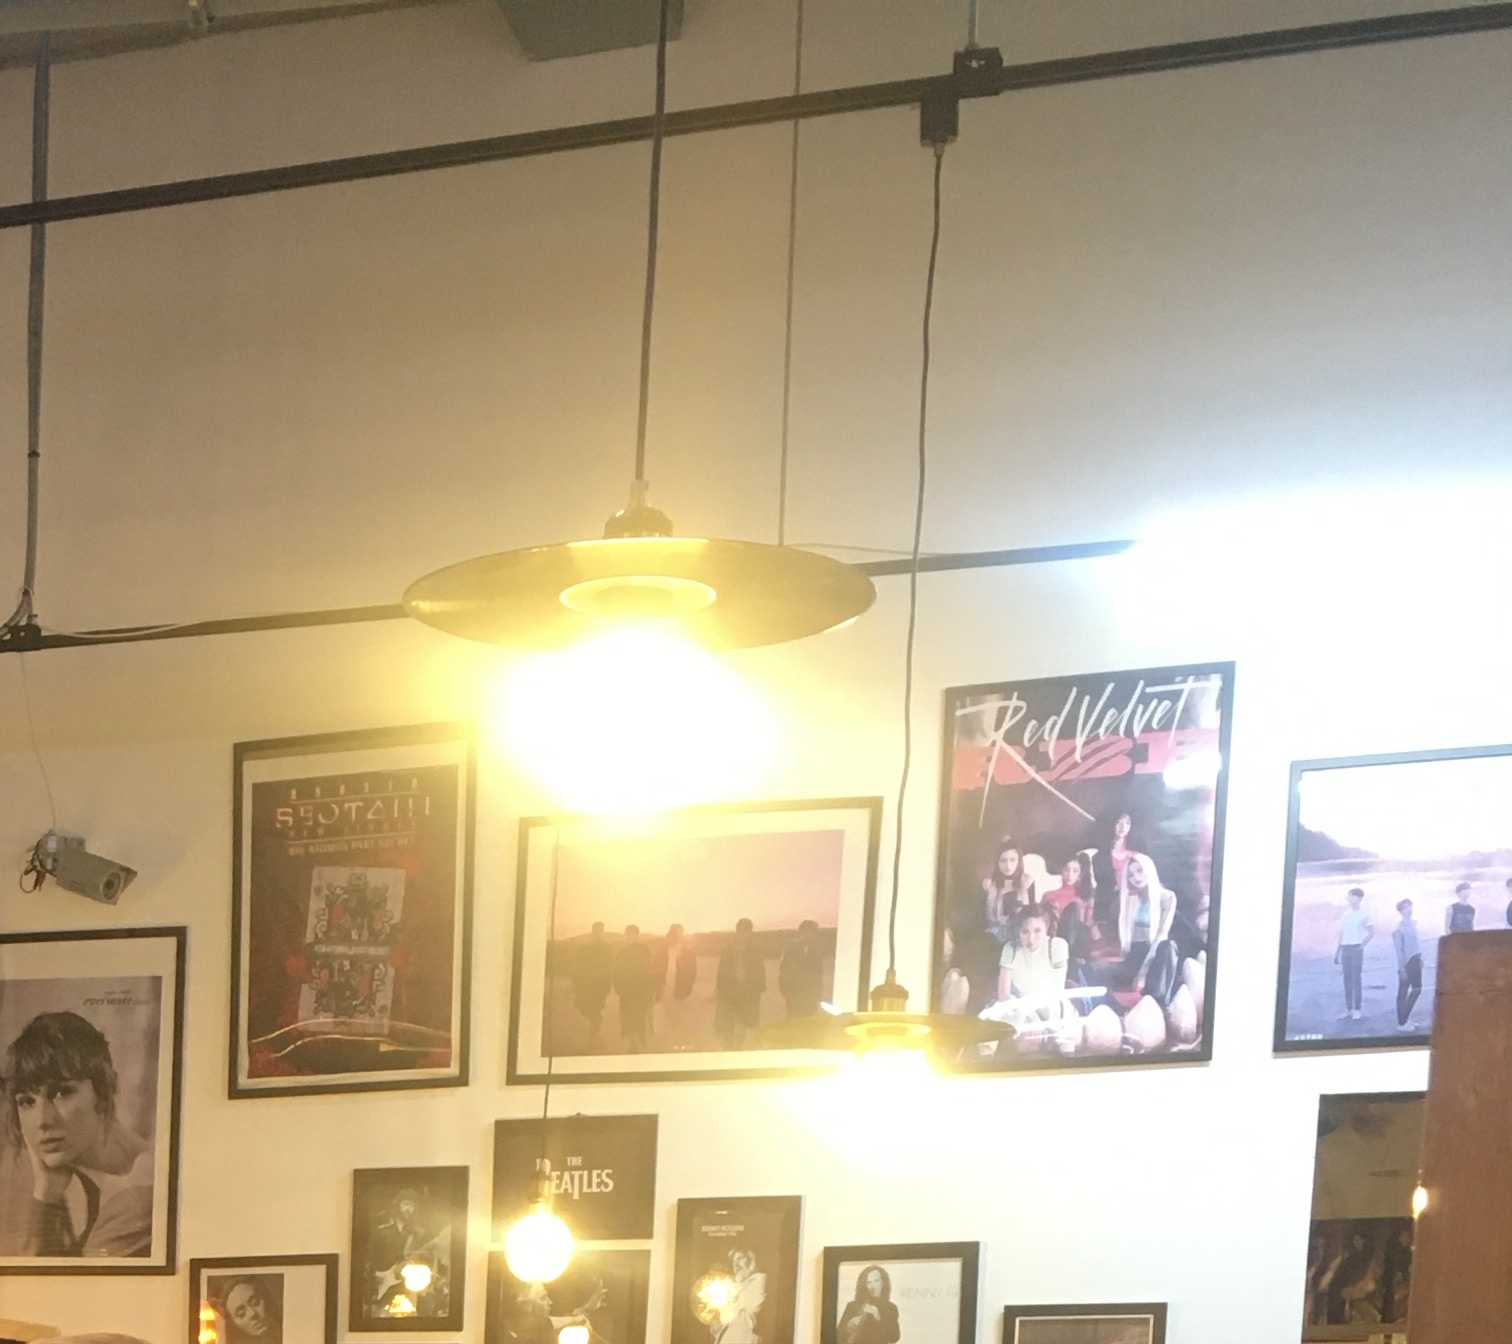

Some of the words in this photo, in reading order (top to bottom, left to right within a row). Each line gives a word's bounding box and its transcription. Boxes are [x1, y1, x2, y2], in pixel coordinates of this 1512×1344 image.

[1075, 676, 1223, 763] Velvet
[566, 1156, 583, 1167] THE
[545, 1169, 614, 1200] EATLES
